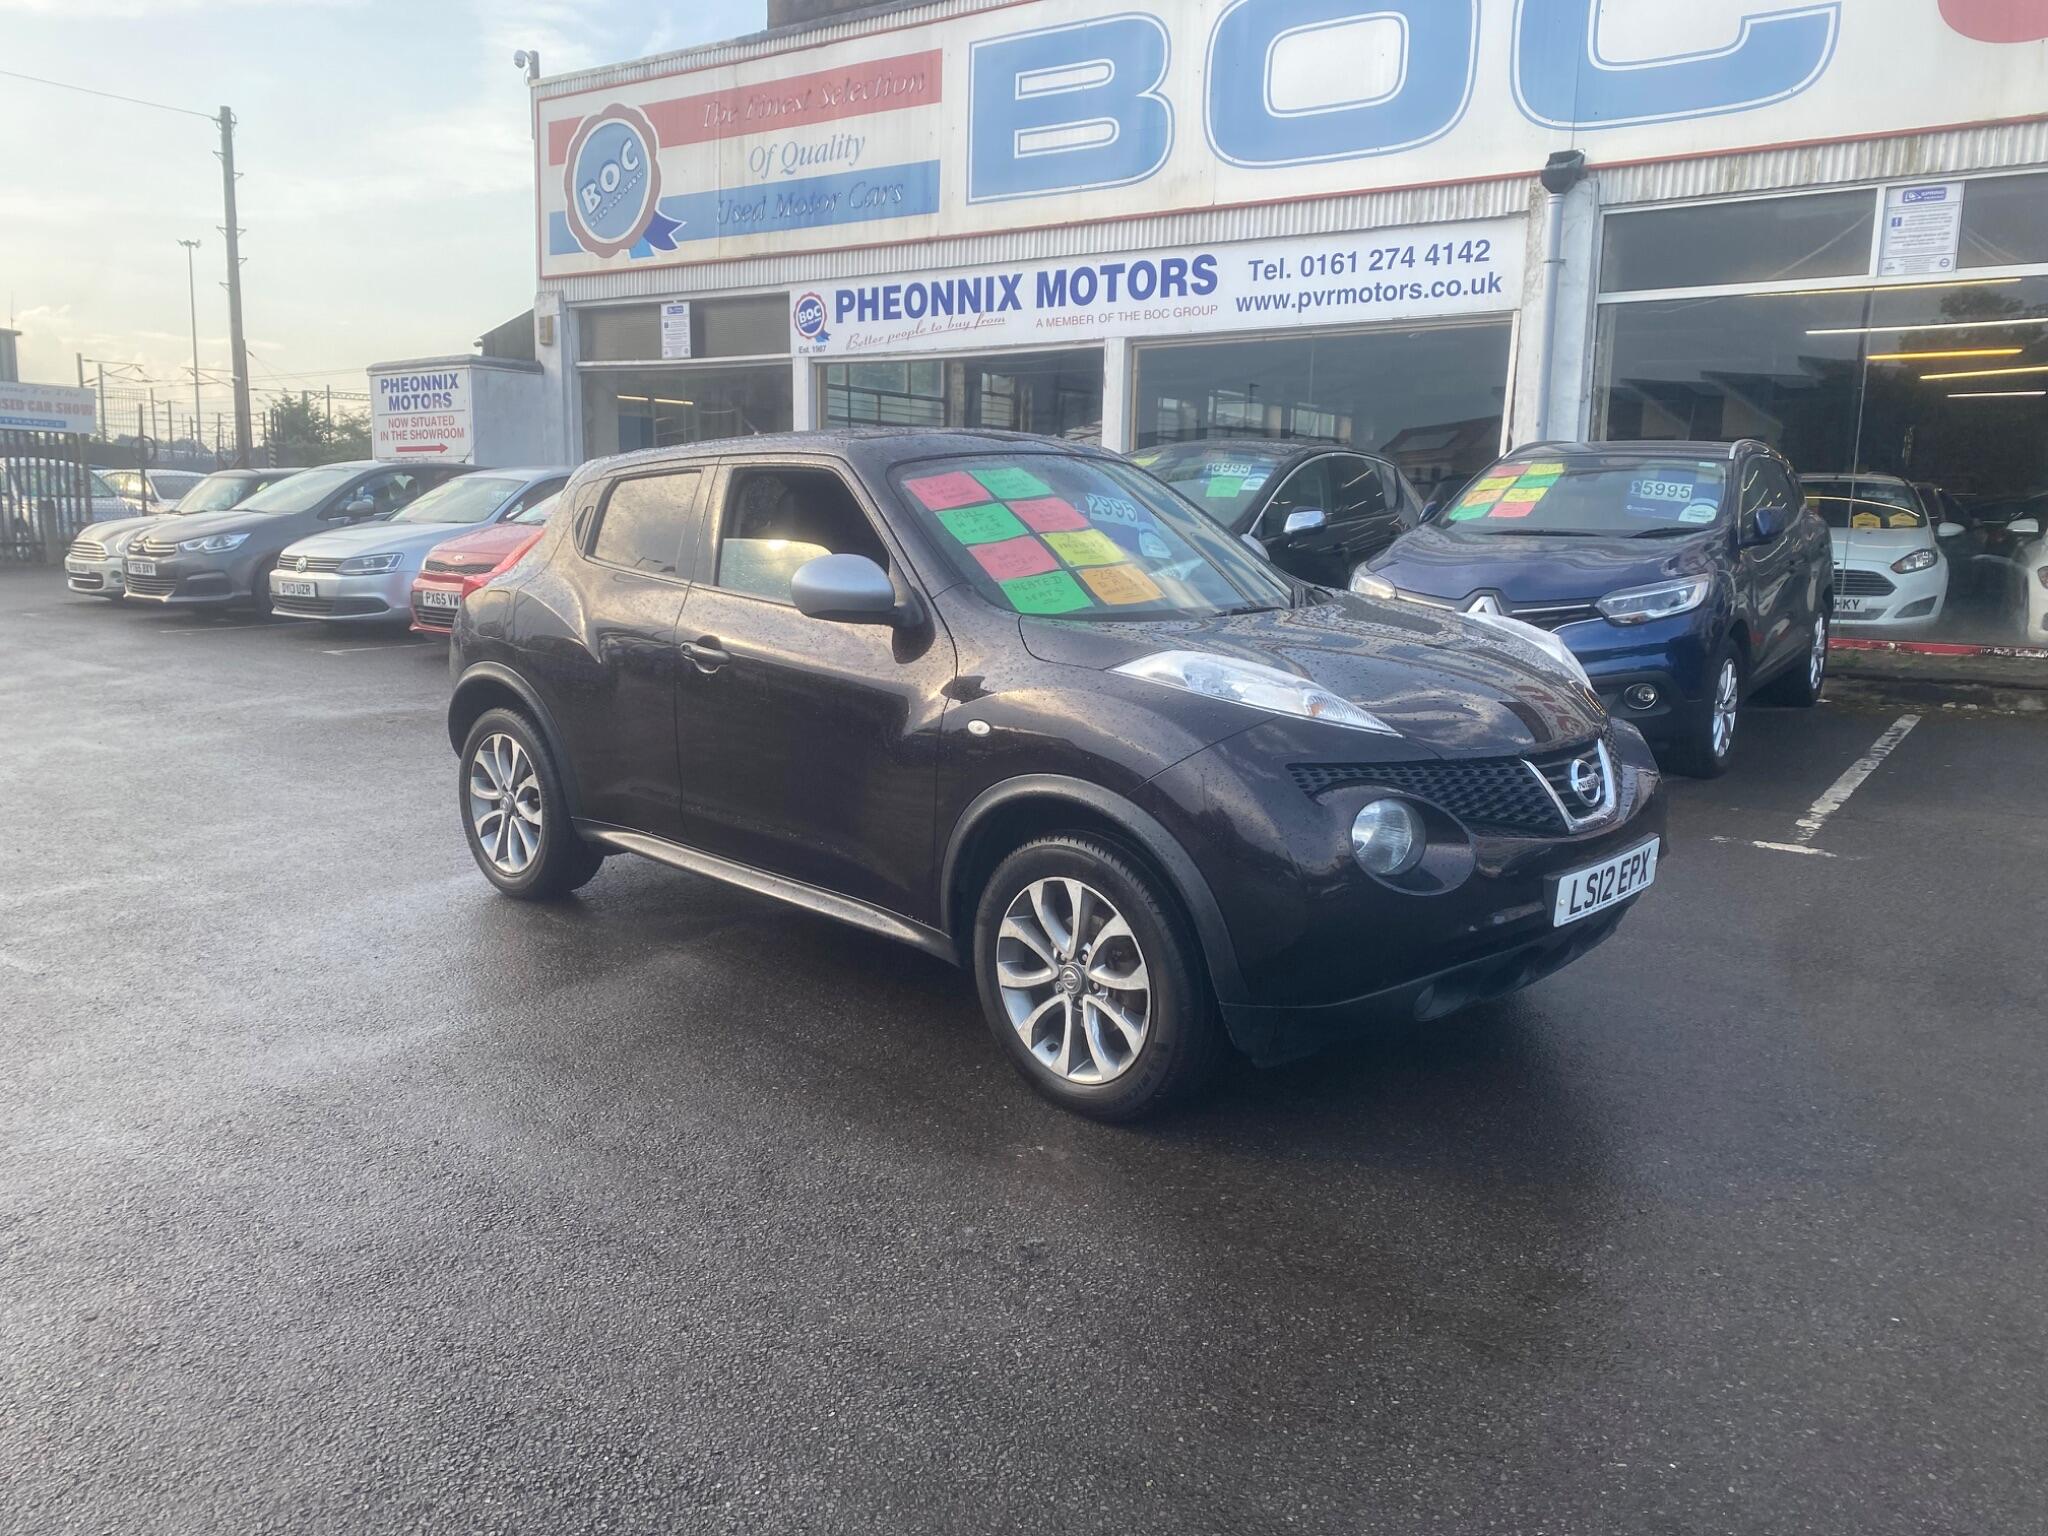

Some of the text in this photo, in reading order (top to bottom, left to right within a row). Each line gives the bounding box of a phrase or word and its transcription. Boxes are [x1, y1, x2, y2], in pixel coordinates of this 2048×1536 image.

[703, 71, 925, 128] The Finest Selection
[581, 138, 639, 215] BOC
[749, 133, 866, 179] Of Quality
[716, 181, 905, 226] Used Motor Cars
[1248, 239, 1492, 282] Tel. 0161 274 4142
[835, 253, 1218, 325] PHEONNIX MOTORS
[1235, 271, 1503, 313] www.pvrmotors.co.uk
[799, 305, 822, 324] BOC
[846, 311, 1006, 350] Better people to buy from
[1036, 305, 1218, 329] A MEMBER OF THE BOC GROUP
[380, 373, 459, 394] PHEONNIX
[388, 392, 453, 412] MOTORS
[380, 427, 465, 441] IN THE SHOWROOM
[388, 415, 455, 429] NOW SITUATED
[1569, 866, 1616, 915] LS12
[1617, 847, 1652, 895] EPX
